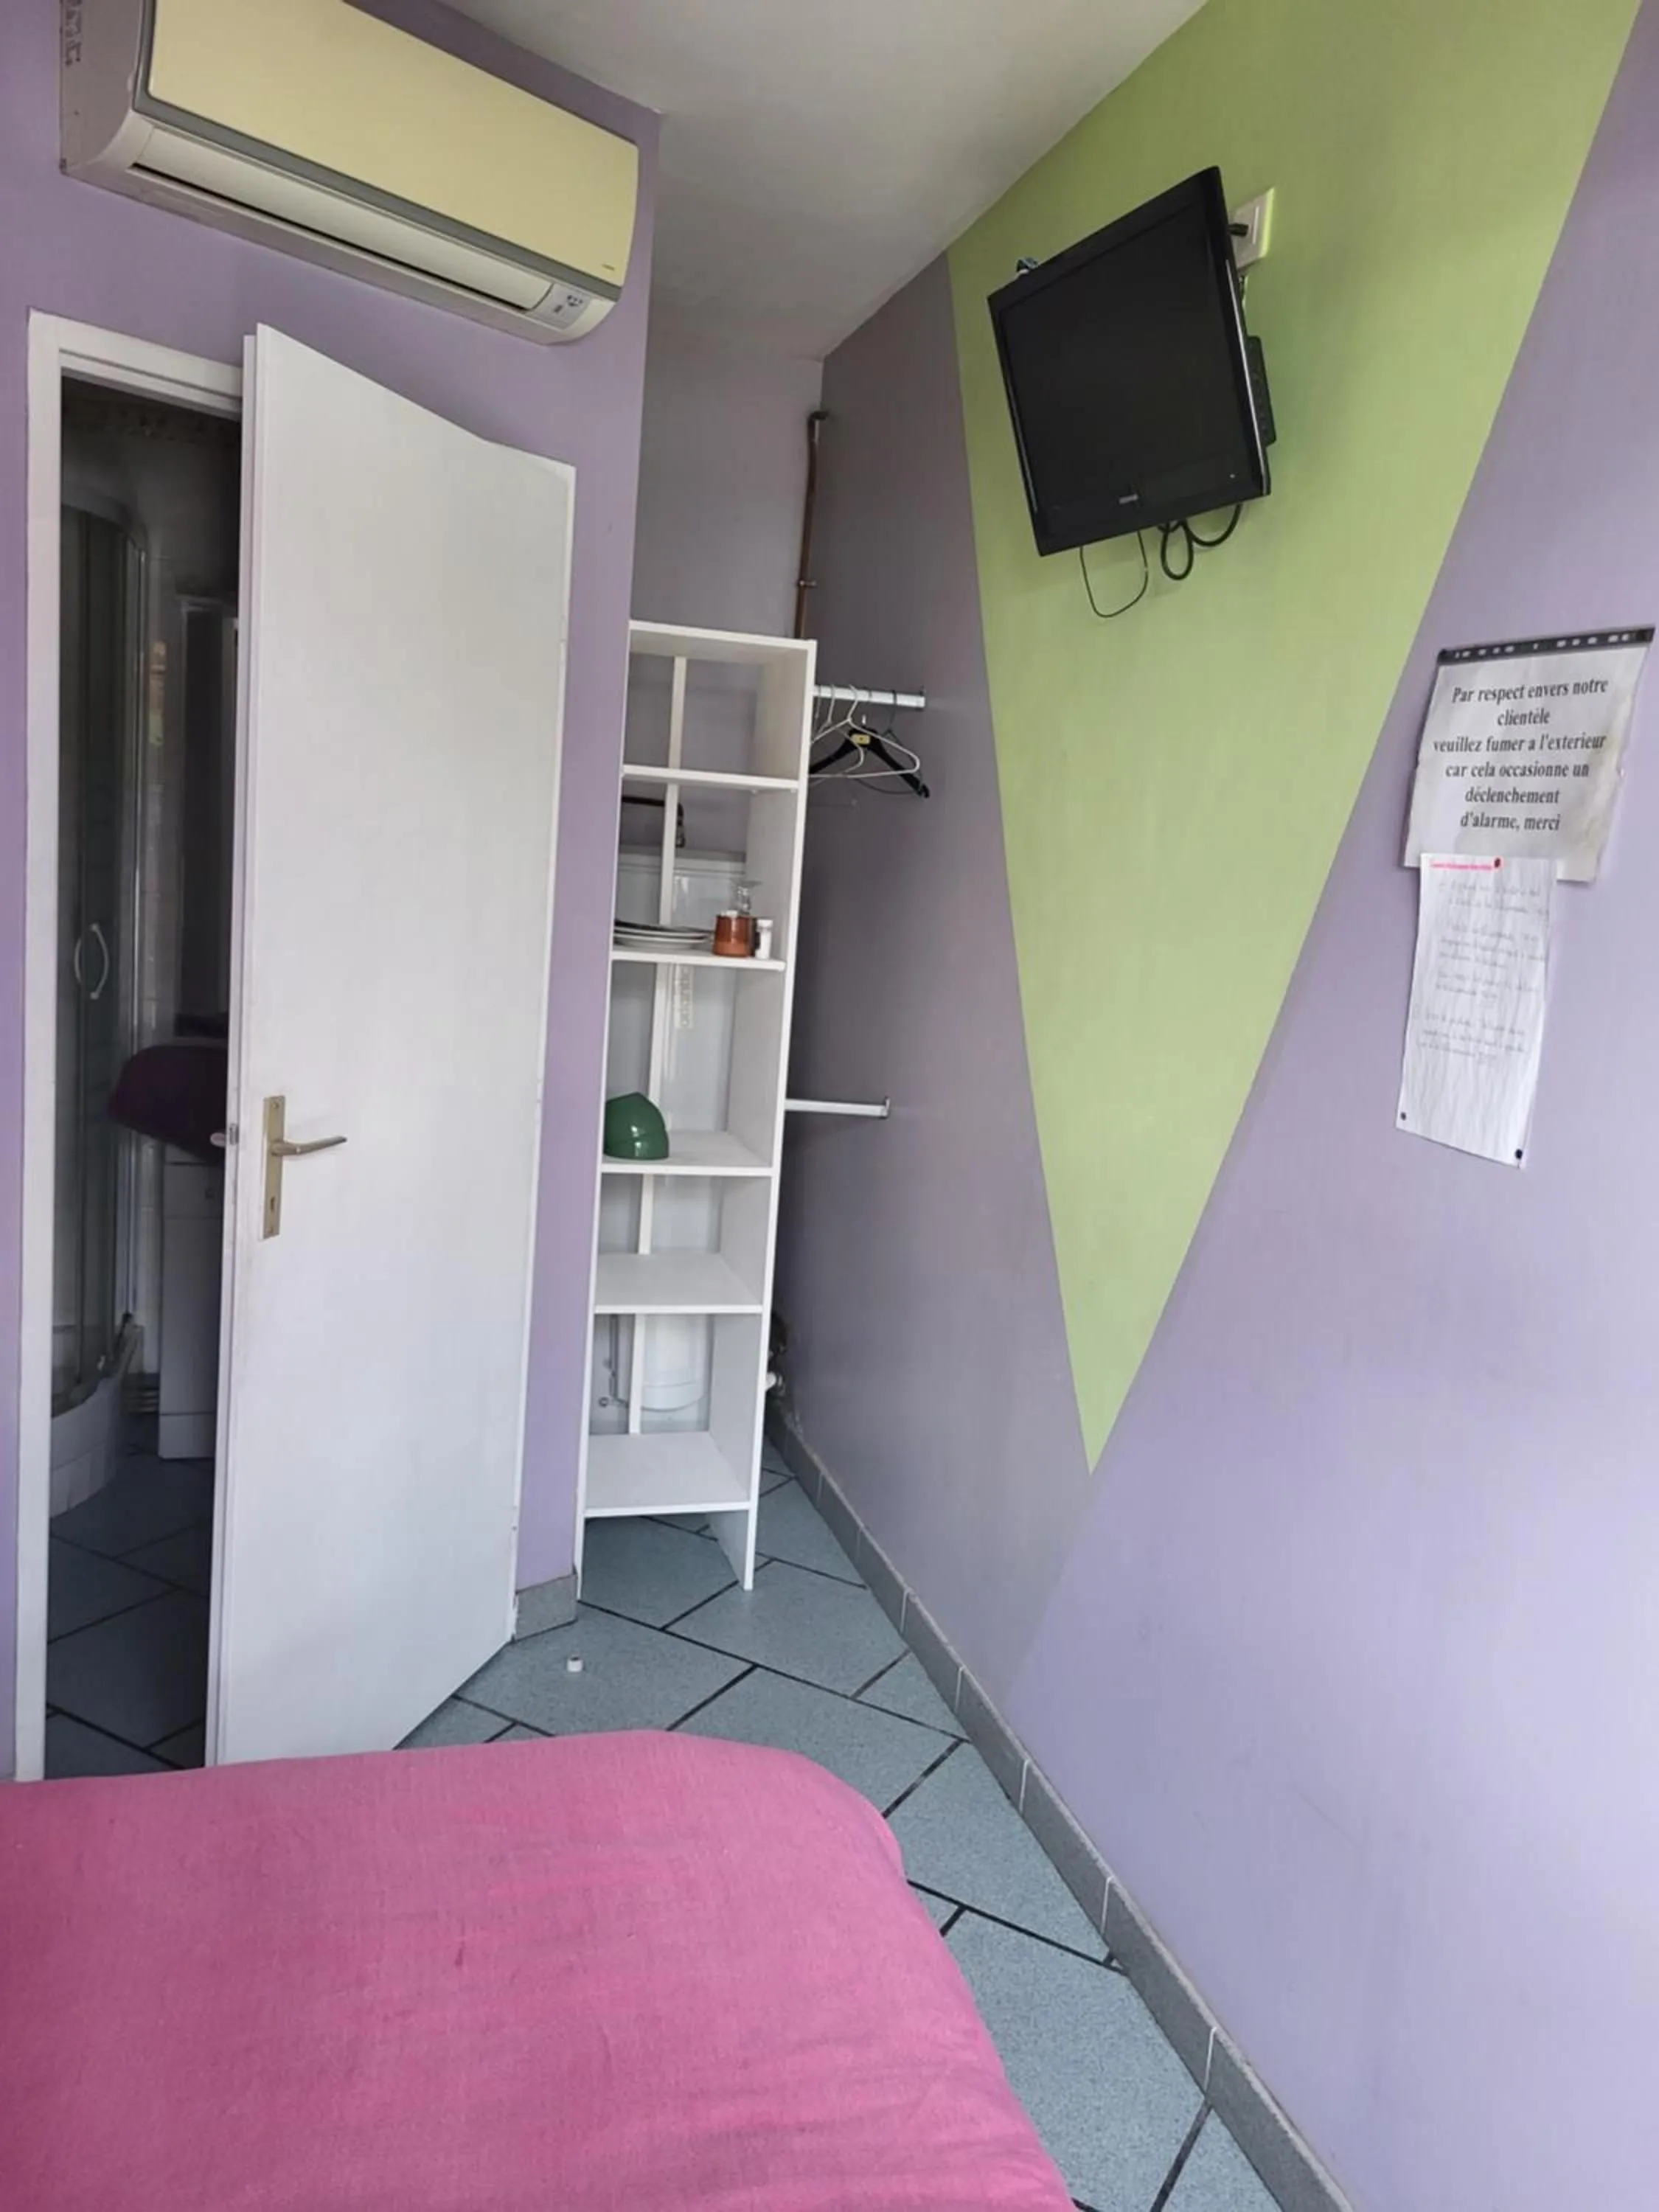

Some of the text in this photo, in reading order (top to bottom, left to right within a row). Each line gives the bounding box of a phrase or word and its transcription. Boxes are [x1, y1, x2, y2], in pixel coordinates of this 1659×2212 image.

[1453, 678, 1608, 706] Par respect envers notre
[1433, 736, 1482, 752] veuillez
[1486, 735, 1524, 752] fumer
[1540, 732, 1607, 751] l'exterieur
[1446, 760, 1590, 778] car cela occasionne un
[1464, 786, 1560, 804] déclenchement
[1460, 811, 1561, 832] d'alarme, merci
